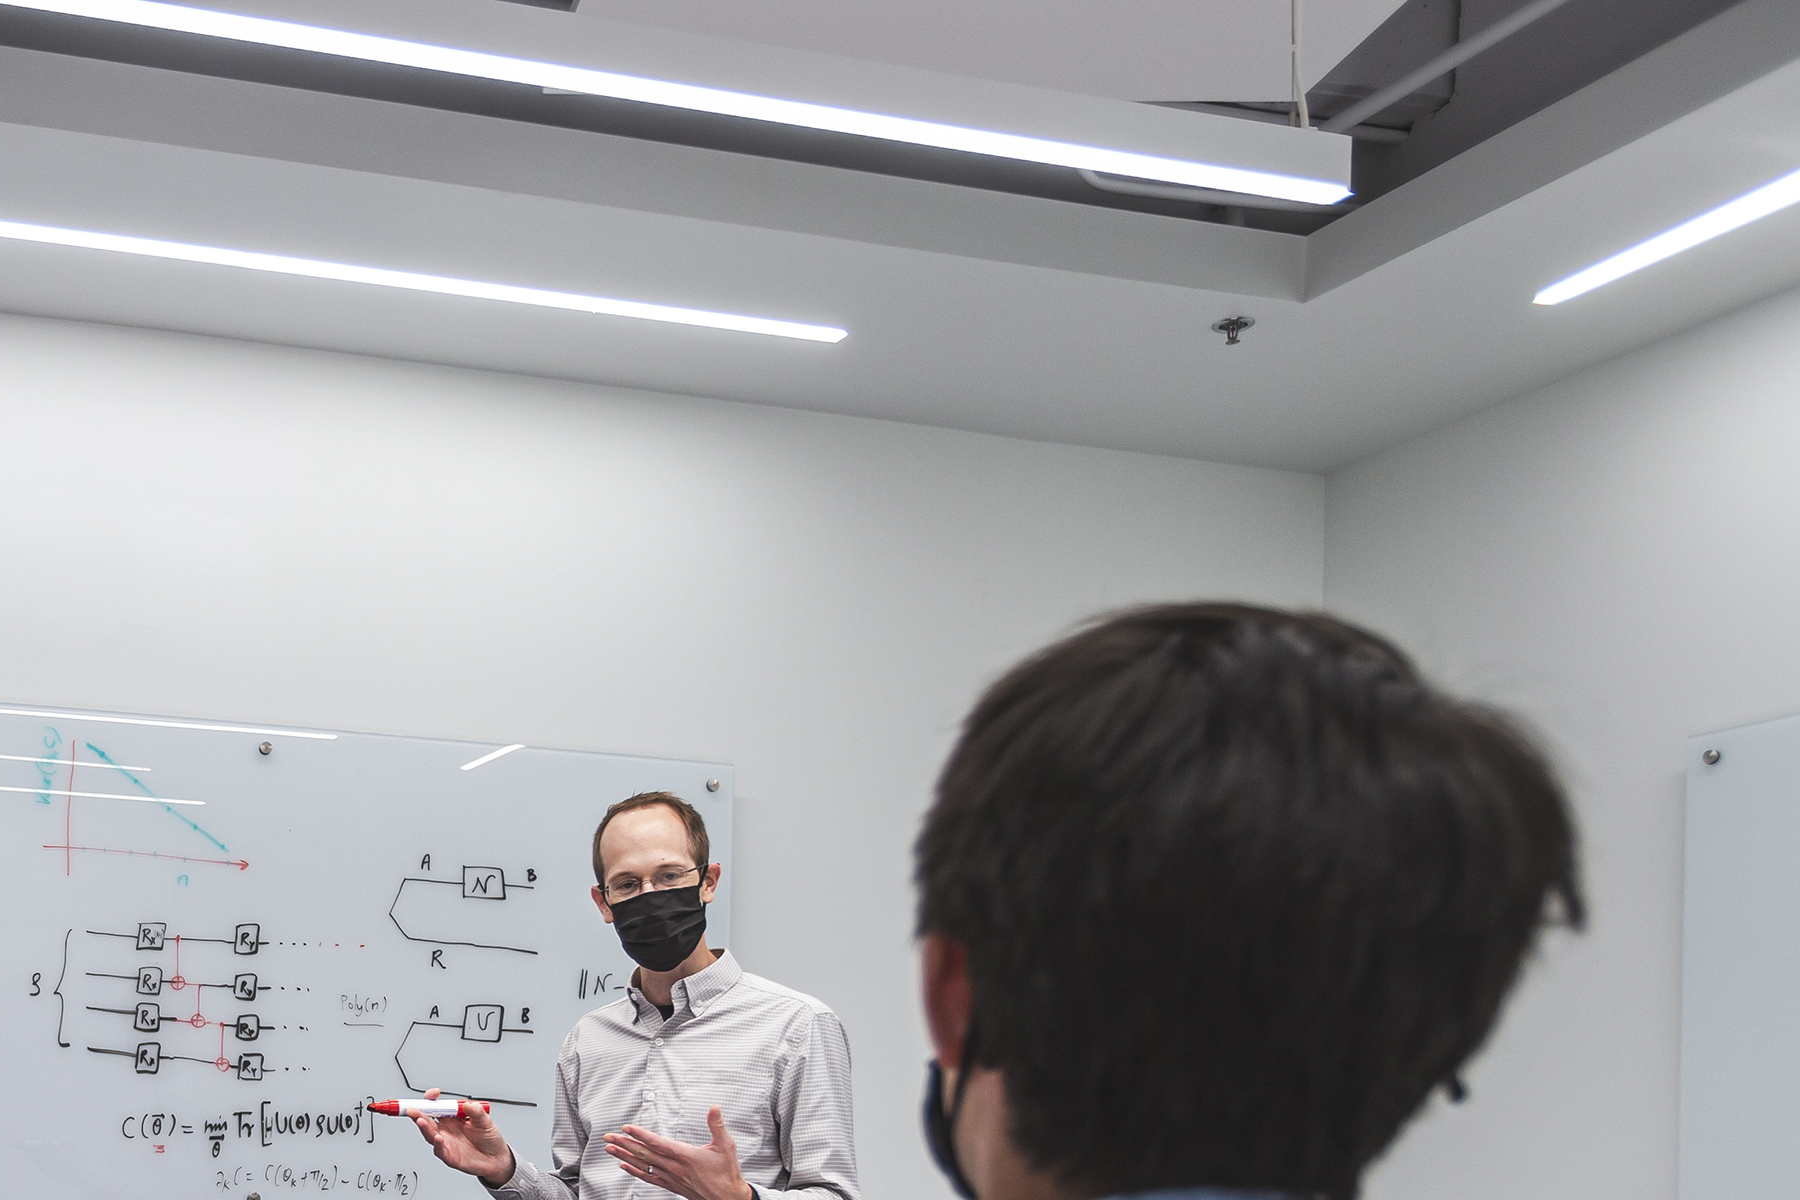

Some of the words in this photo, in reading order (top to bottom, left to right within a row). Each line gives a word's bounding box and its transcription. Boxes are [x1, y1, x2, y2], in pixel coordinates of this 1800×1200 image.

[421, 853, 431, 871] A
[527, 868, 537, 882] B
[471, 874, 496, 894] N
[431, 949, 446, 969] R
[429, 1005, 439, 1019] A
[521, 1007, 530, 1024] B
